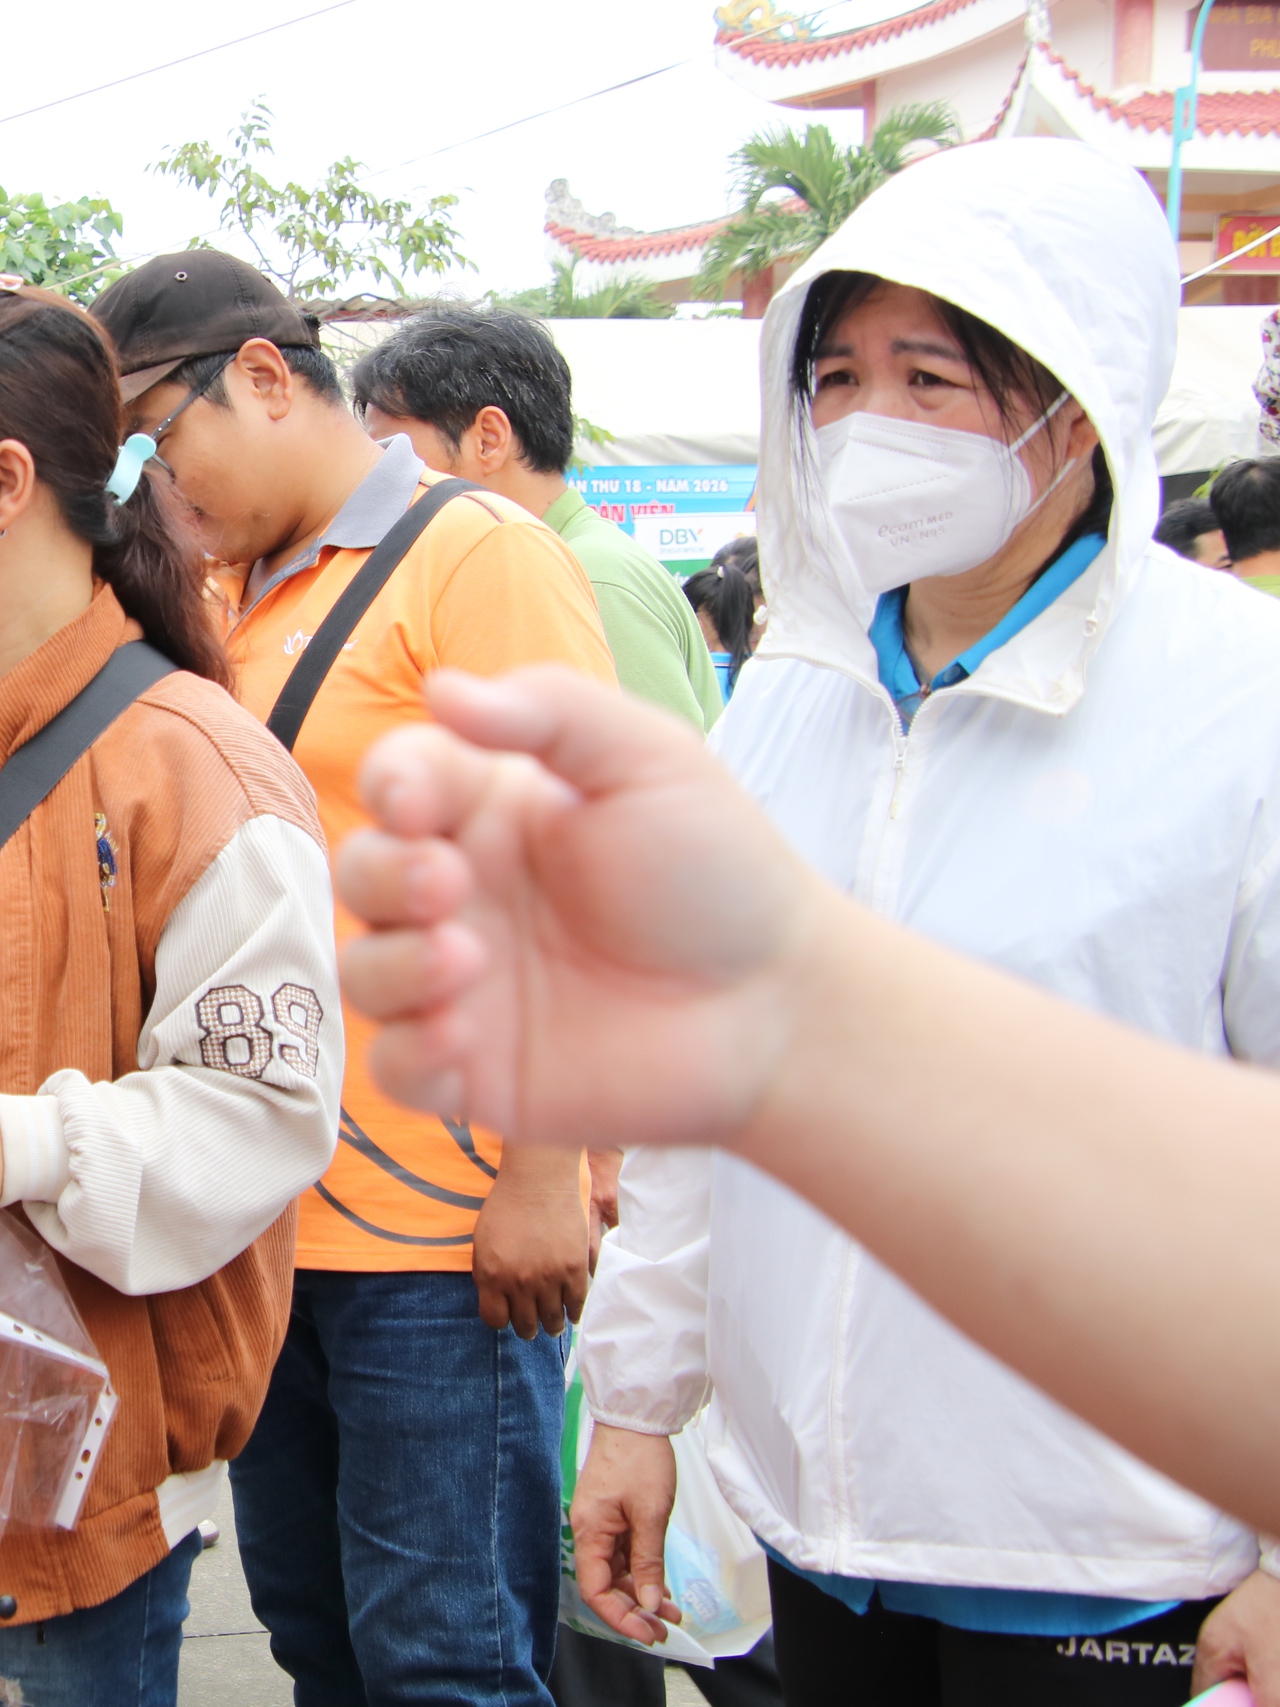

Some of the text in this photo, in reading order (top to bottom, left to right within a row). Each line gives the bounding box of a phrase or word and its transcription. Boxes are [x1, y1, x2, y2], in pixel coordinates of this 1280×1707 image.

[624, 479, 643, 494] 18
[655, 476, 690, 493] NĂM
[693, 478, 729, 494] 2026
[659, 528, 704, 546] DBV
